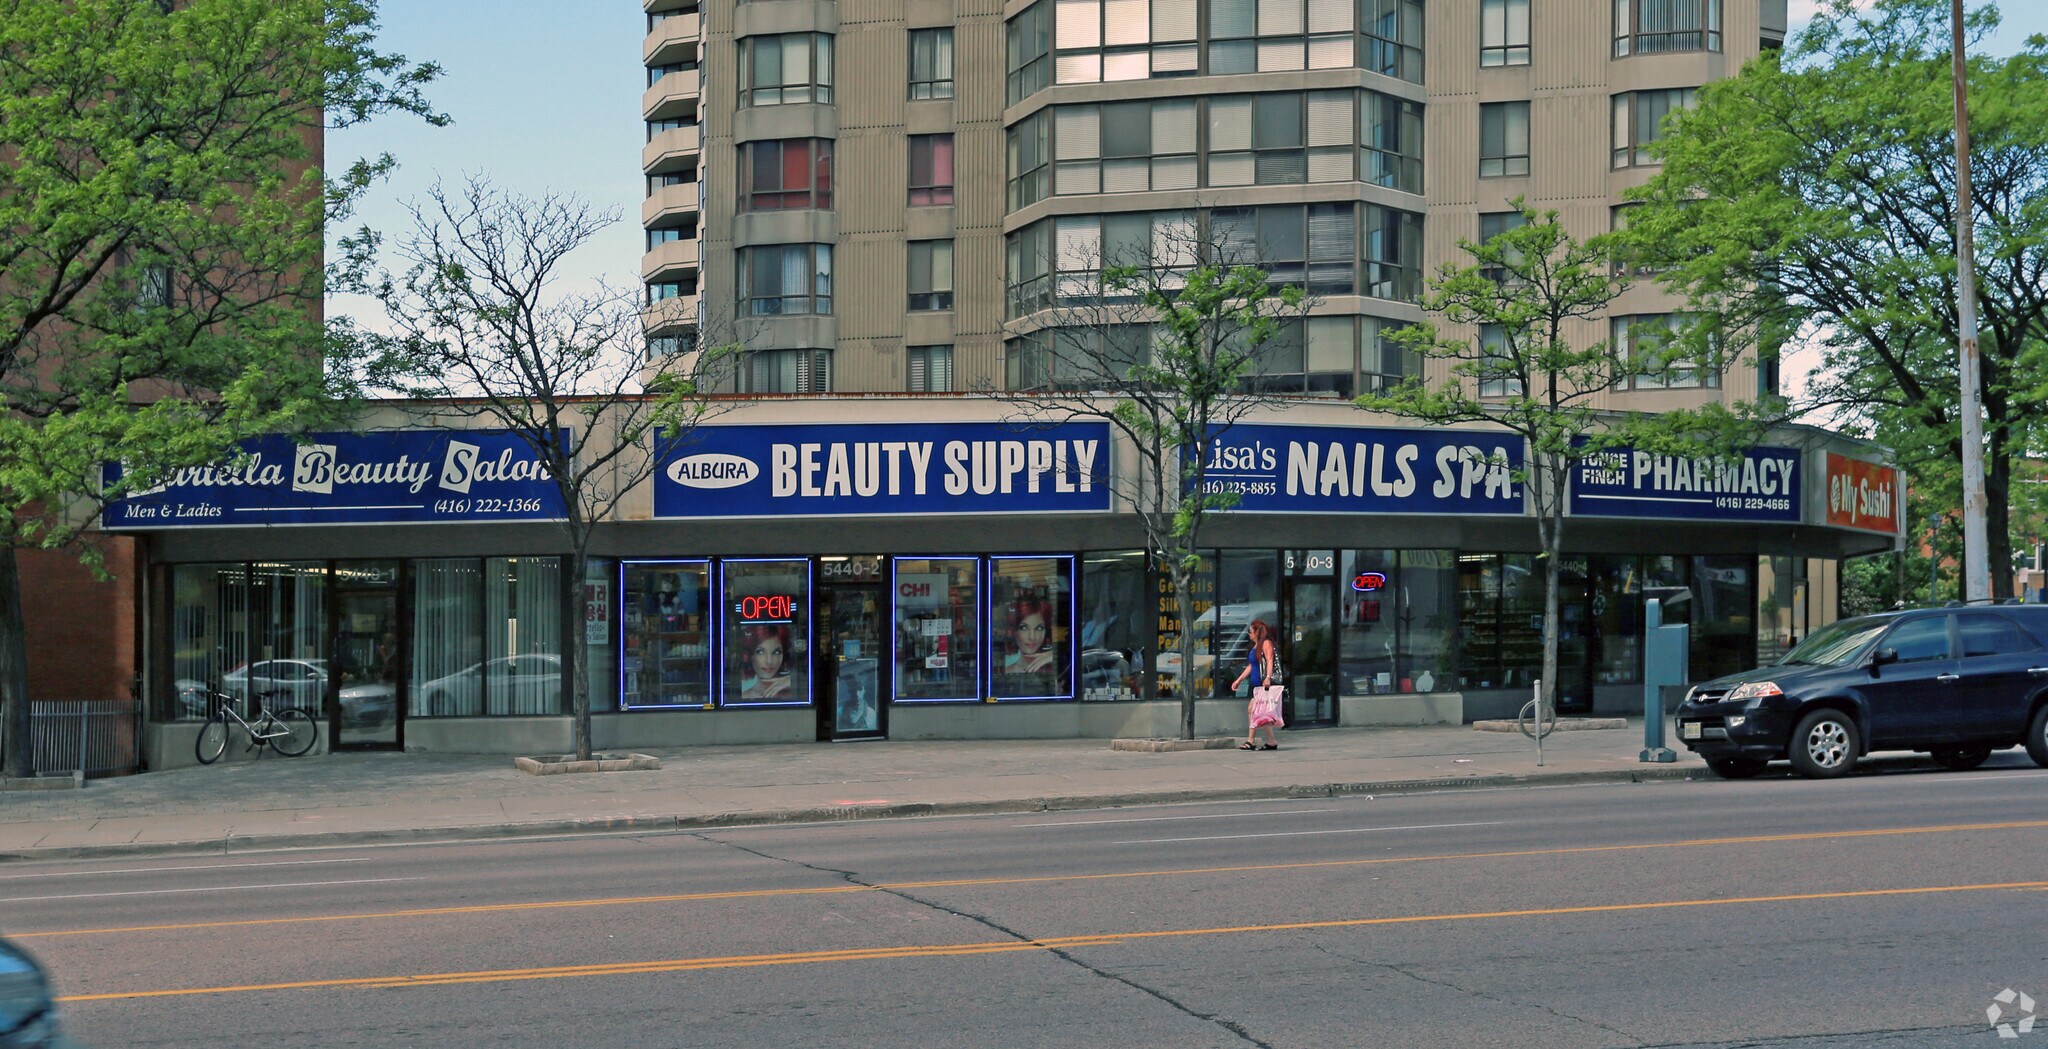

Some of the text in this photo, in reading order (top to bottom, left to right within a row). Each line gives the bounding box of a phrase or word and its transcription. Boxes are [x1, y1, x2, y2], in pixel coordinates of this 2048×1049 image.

[297, 450, 432, 494] Beauty
[445, 447, 552, 485] Salon
[677, 462, 749, 480] ALBURA
[771, 439, 1099, 497] BEAUTY SUPPLY
[1285, 440, 1512, 499] NAILS SPA
[1582, 468, 1626, 485] FINCH
[1632, 450, 1795, 496] PHARMACY
[1226, 481, 1277, 495] 225-8855
[434, 498, 542, 514] (416) 222-1366
[1716, 496, 1790, 510] (416) 229-4666
[1841, 473, 1890, 525] My Sushi
[124, 502, 222, 519] Men & Ladies
[823, 562, 880, 576] 5440-2
[899, 583, 931, 597] CHI
[1158, 578, 1213, 594] Ge ails
[1353, 576, 1383, 589] OPEN
[742, 596, 791, 619] OPEN
[1191, 600, 1215, 614] raps
